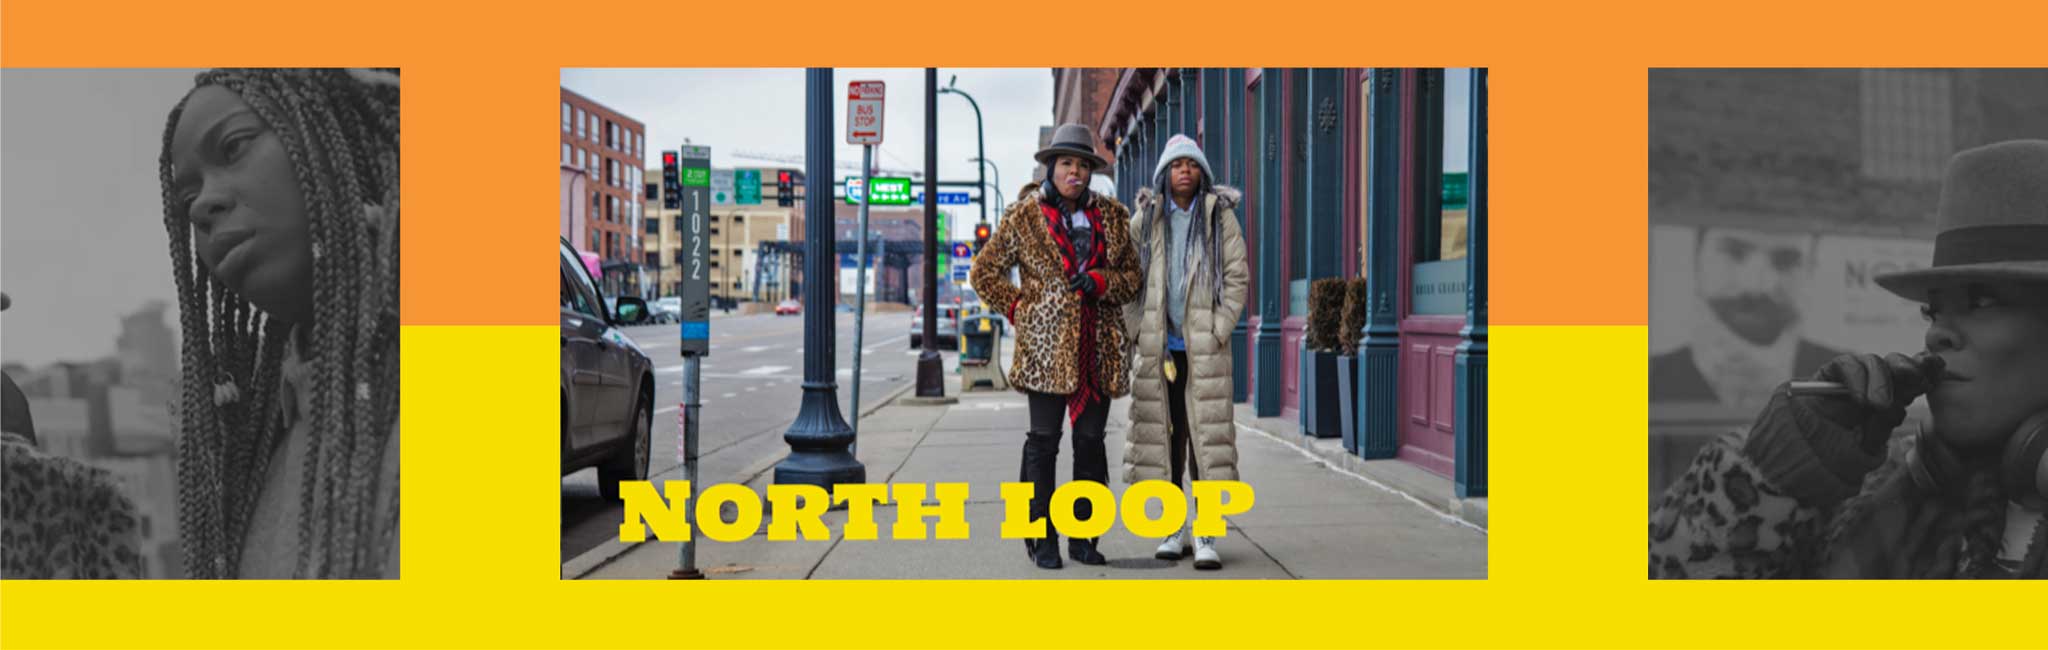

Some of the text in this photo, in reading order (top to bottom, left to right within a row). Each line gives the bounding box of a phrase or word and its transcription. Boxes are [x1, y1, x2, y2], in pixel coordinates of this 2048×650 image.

[857, 104, 874, 114] BUS
[855, 116, 876, 127] STOP
[691, 190, 701, 280] 1022
